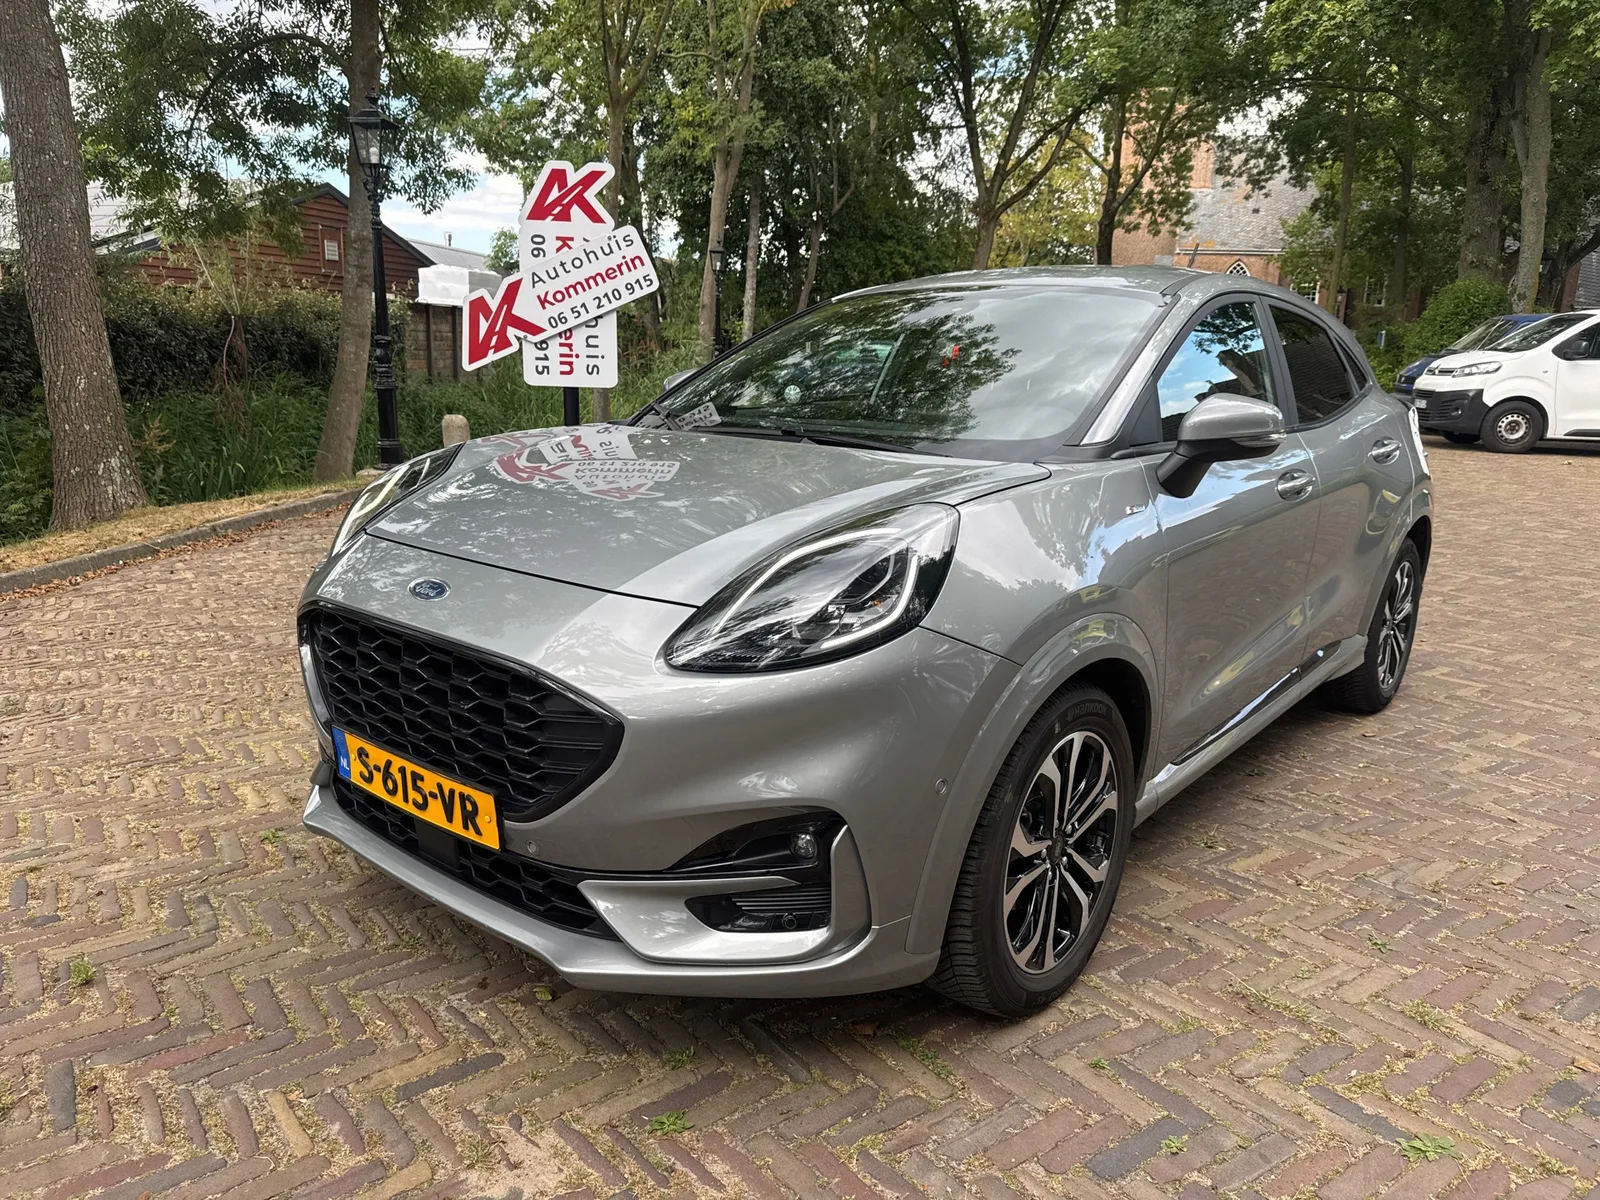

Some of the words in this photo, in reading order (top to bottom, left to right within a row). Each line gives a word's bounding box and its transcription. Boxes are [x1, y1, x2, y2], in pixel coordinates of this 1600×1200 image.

[530, 234, 546, 258] 06
[531, 233, 635, 289] Autohuis
[536, 253, 646, 311] Kommerin
[547, 312, 568, 329] 06
[570, 302, 590, 320] 51
[593, 288, 622, 310] 210
[624, 273, 654, 296] 915
[534, 340, 550, 376] 915
[340, 756, 350, 771] NL
[356, 746, 483, 837] S-615-VR
